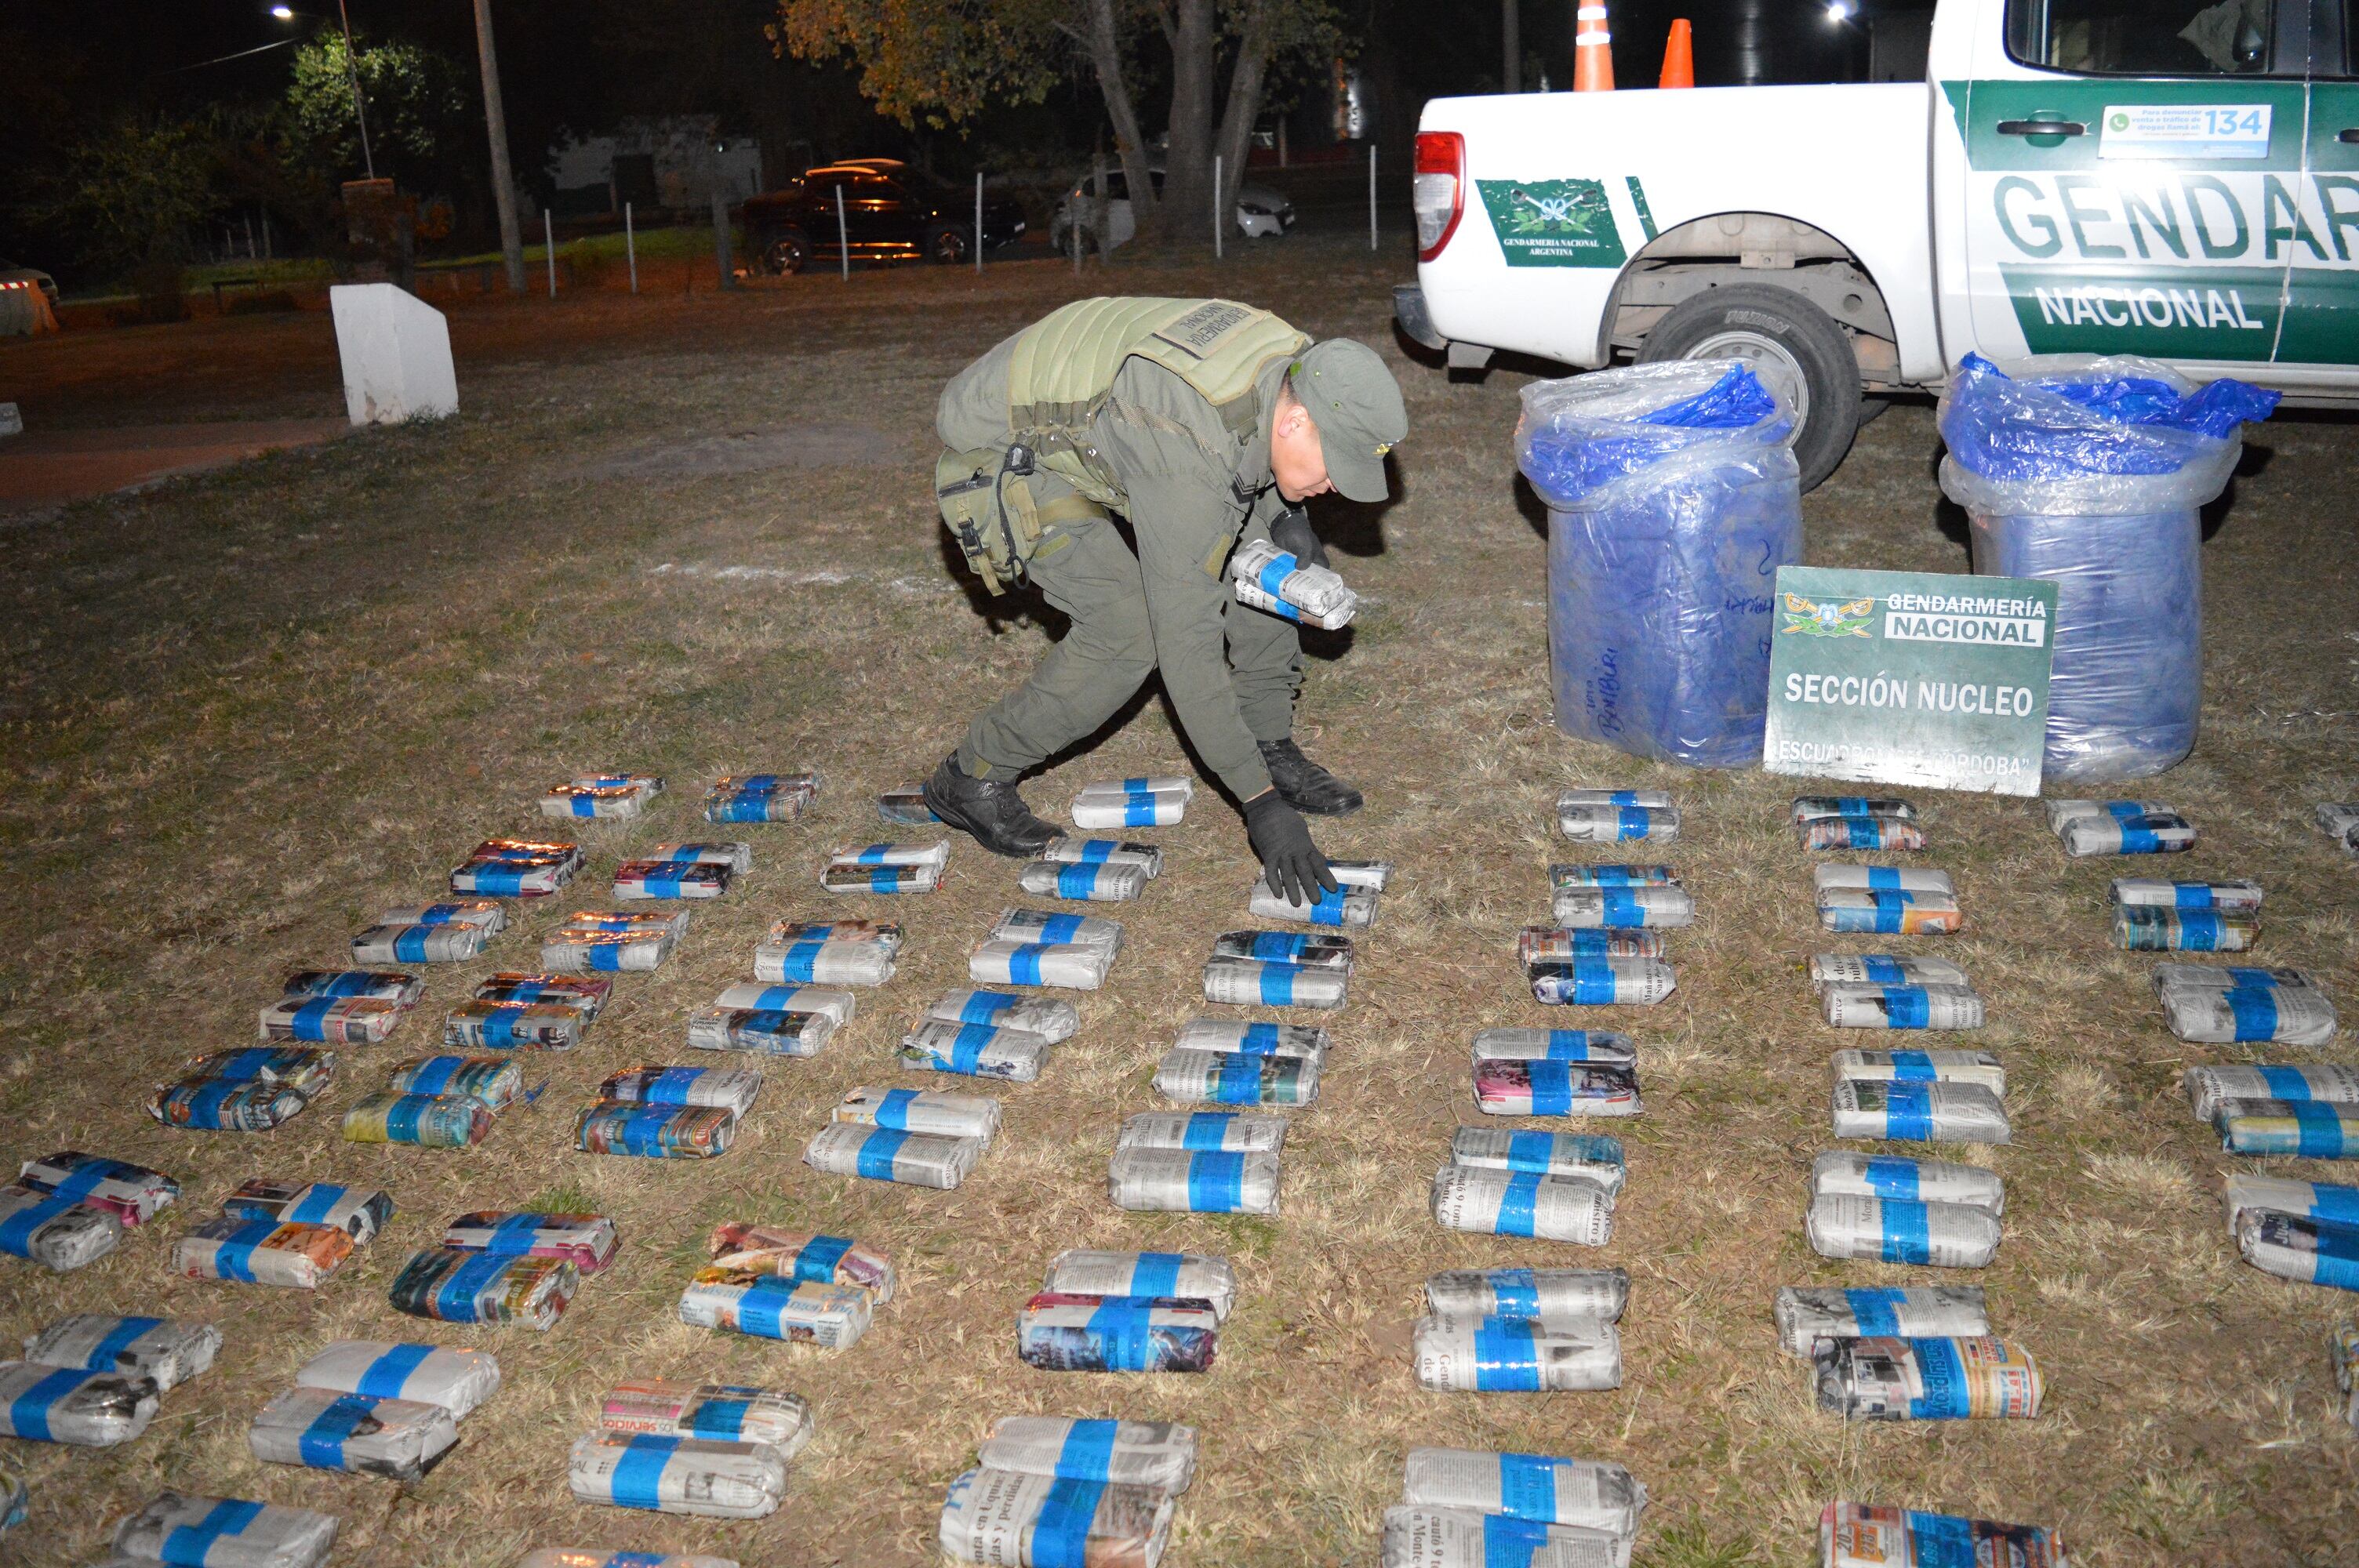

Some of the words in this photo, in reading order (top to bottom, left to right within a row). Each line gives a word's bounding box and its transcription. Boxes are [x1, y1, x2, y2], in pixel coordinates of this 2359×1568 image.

[2205, 109, 2263, 135] 134
[1503, 238, 1560, 246] GENDARMERIA
[1560, 239, 1600, 248] NACIONAL
[1529, 248, 1573, 256] ARGENTINA
[1179, 305, 1224, 330] NACIONAL
[2034, 285, 2264, 329] NACIONAL
[1185, 307, 1251, 348] GENDARMERIA
[1725, 310, 1790, 335] FUZION
[1887, 593, 2047, 618] GENDARMERÍA
[1892, 616, 2037, 644] NACIONAL
[1784, 670, 1908, 709] SECCIÓN
[1917, 681, 2034, 717] NUCLEO
[1441, 1177, 1455, 1206] Monte
[1455, 1192, 1465, 1202] 9
[1423, 1358, 1434, 1373] de
[602, 1417, 657, 1431] servicios
[998, 1474, 1026, 1521] pérdidas
[976, 1515, 988, 1530] en
[993, 1524, 1007, 1534] y
[1412, 1525, 1426, 1563] Monte
